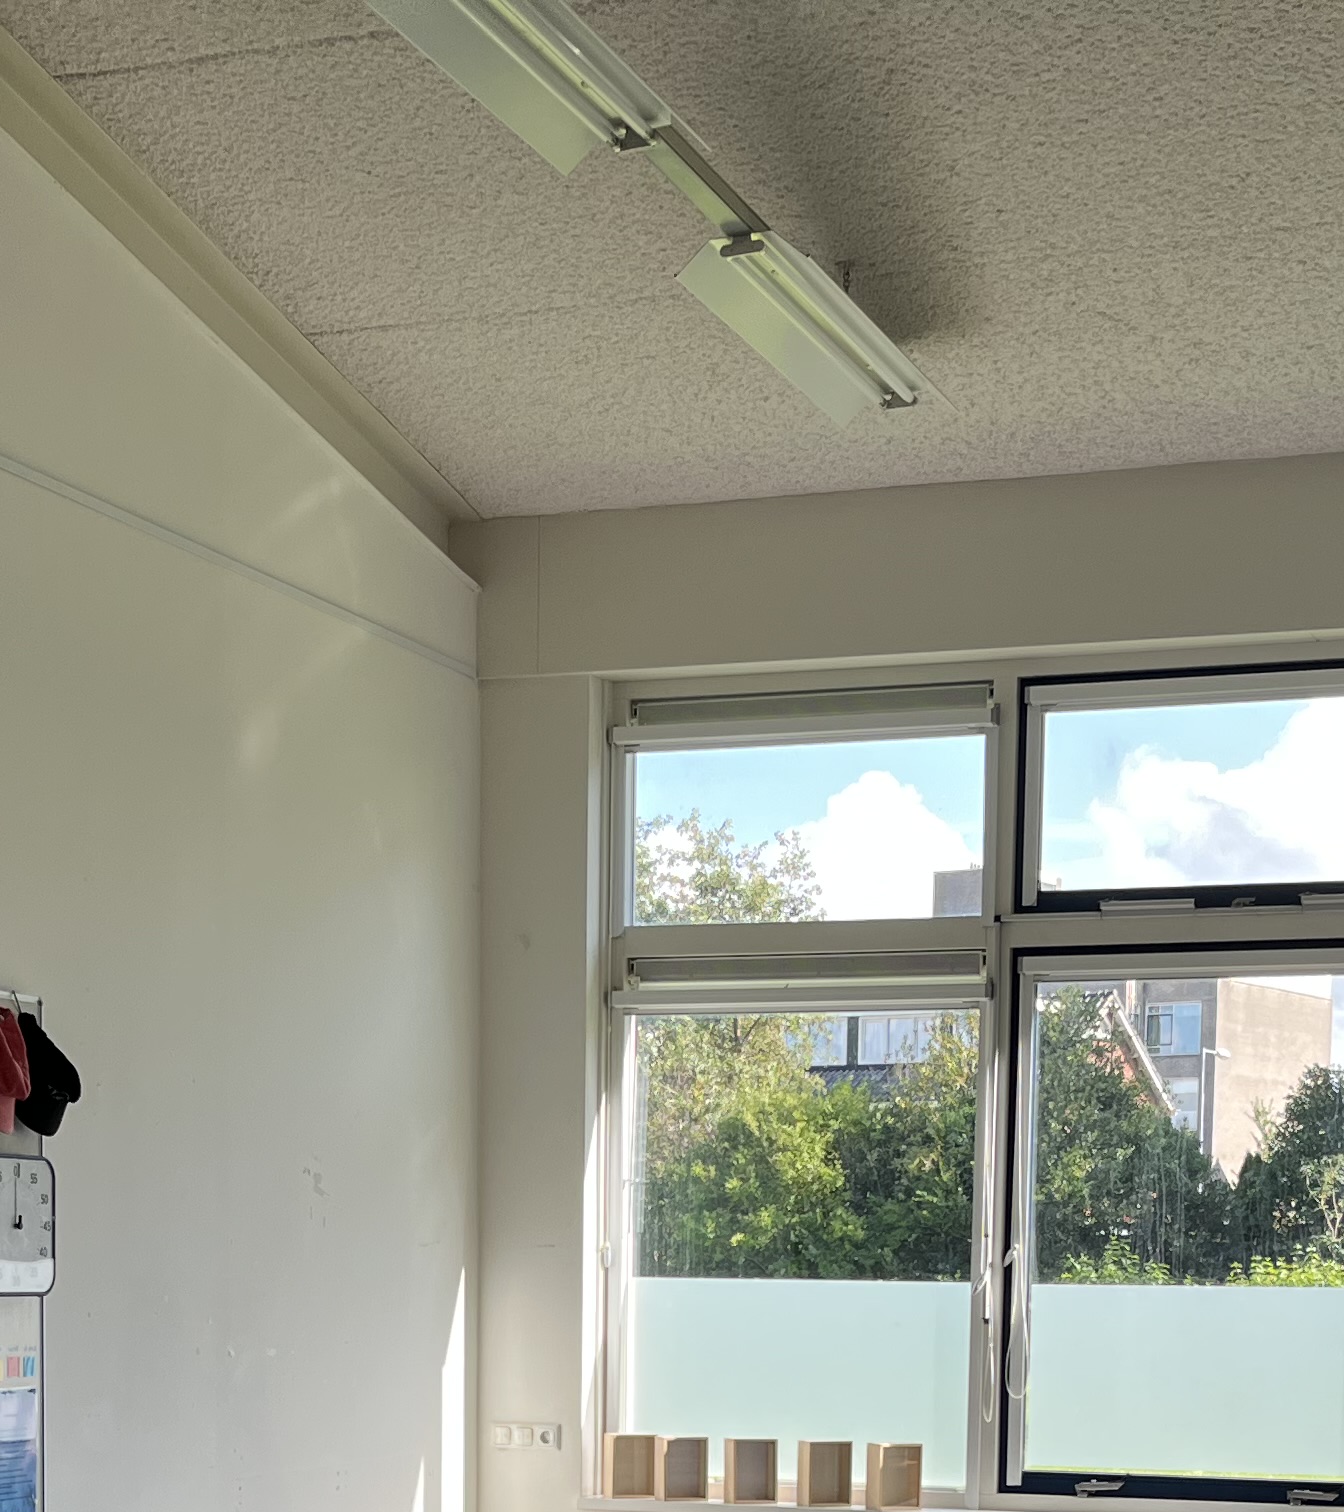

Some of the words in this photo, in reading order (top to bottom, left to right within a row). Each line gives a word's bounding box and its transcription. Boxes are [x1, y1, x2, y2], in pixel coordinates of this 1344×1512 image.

[30, 1173, 38, 1184] 55
[41, 1194, 49, 1204] 50
[43, 1221, 51, 1231] 45
[39, 1247, 48, 1257] 40
